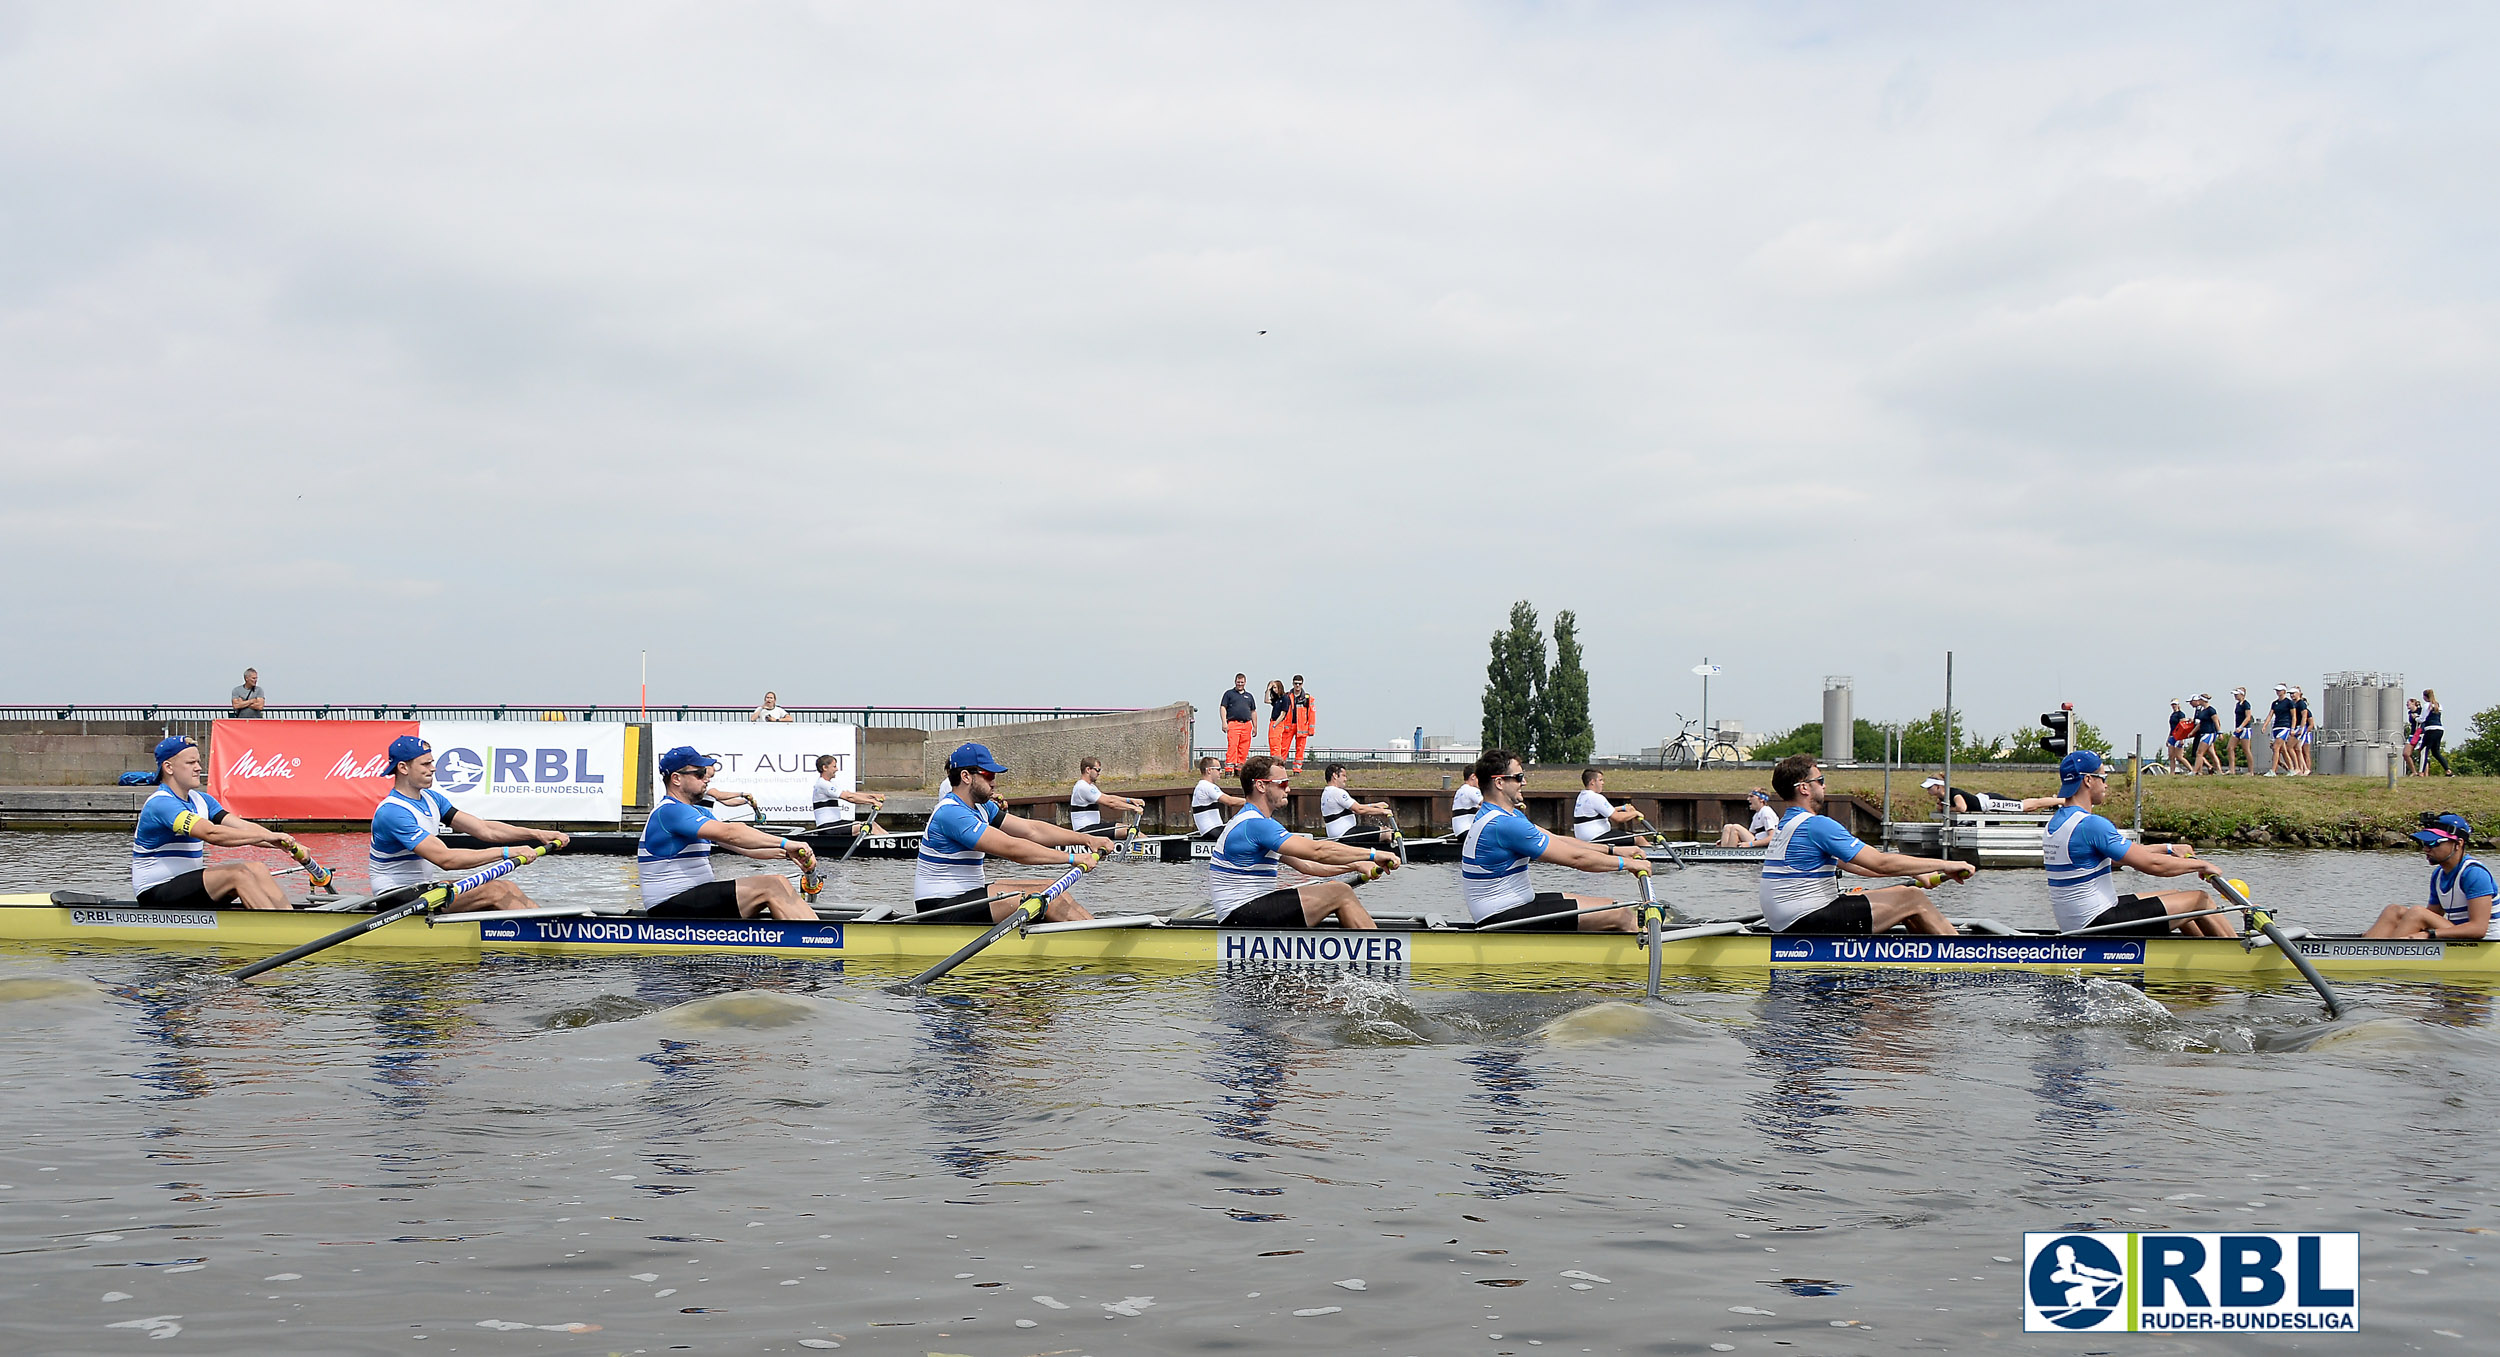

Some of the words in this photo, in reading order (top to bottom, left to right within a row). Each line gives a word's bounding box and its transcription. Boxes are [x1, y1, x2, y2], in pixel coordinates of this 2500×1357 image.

[494, 748, 605, 784] RBL
[754, 753, 851, 773] AUDT
[493, 785, 604, 795] RUDER-BUNDESLIGA
[869, 838, 897, 849] LTS
[1683, 848, 1704, 856] RBL
[87, 911, 114, 921] RBL
[116, 913, 216, 925] RUDER-BUNDESLIGA
[536, 920, 573, 938] TÜV
[578, 923, 633, 940] NORD
[638, 924, 785, 943] Maschseeachter
[1226, 936, 1403, 961] HANNOVER
[1790, 950, 1809, 958] NORD
[1831, 939, 1870, 958] TÜV
[1875, 942, 1933, 959] NORD
[1938, 943, 2087, 960] Maschseeachter
[2301, 943, 2330, 954] RBL
[2332, 945, 2441, 956] RUDER-BUNDESLIGA
